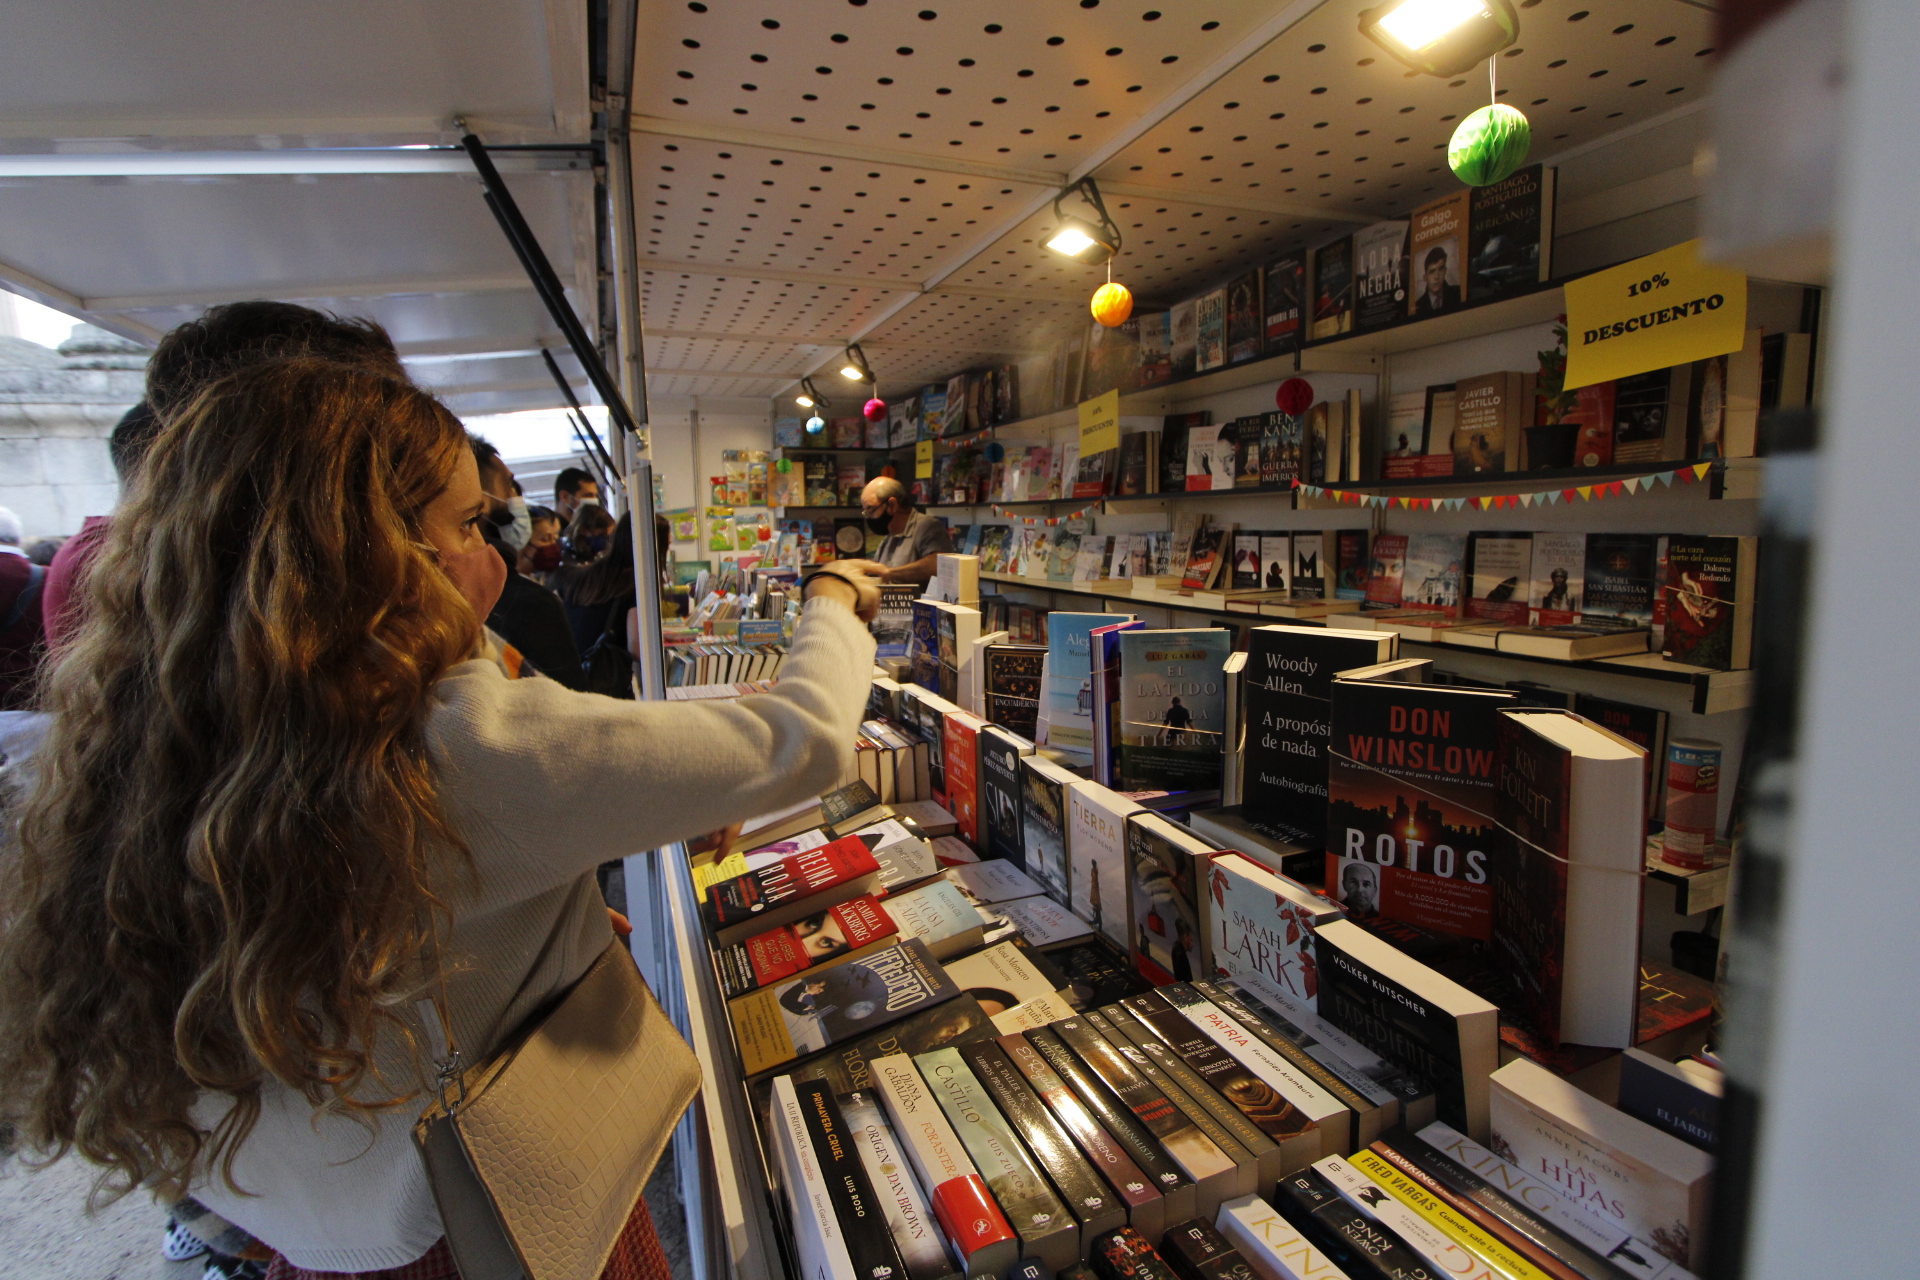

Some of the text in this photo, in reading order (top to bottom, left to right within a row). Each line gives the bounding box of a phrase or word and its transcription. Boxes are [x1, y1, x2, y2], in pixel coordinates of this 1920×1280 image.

[1474, 182, 1537, 210] POSTEGUILLO
[1481, 173, 1529, 198] SANTIAGO
[1415, 219, 1460, 242] corredor
[1421, 210, 1452, 228] Galgo
[1360, 243, 1402, 273] LOBA
[1359, 270, 1402, 299] NEGRA
[1627, 271, 1670, 298] 10%
[1582, 293, 1725, 346] DESCUENTO
[1458, 396, 1502, 411] CASTILLO
[1464, 386, 1495, 400] JAVIER
[1264, 423, 1298, 438] KANE
[1269, 412, 1295, 426] BEN
[1262, 460, 1299, 471] GUERRA
[1670, 553, 1731, 563] norte del corazón
[1676, 545, 1686, 553] La
[1604, 576, 1630, 585] ISABEL
[1699, 572, 1731, 583] Redondo
[1703, 563, 1731, 573] Dolores
[1588, 582, 1603, 591] SAN
[1167, 665, 1187, 678] EL
[1265, 652, 1318, 677] Woody
[1137, 681, 1218, 697] LATIDO
[1189, 708, 1209, 720] LA
[1261, 711, 1273, 727] A
[1390, 705, 1451, 739] DON
[1604, 709, 1631, 726] DON
[1137, 732, 1219, 747] TIERRA
[1261, 732, 1278, 749] de
[1348, 733, 1494, 778] WINSLOW
[1515, 746, 1537, 783] KEN
[1259, 771, 1328, 797] Autobiografía
[1500, 763, 1552, 829] FOLLETT
[1073, 799, 1117, 843] TIERRA
[1090, 834, 1114, 853] MORENO
[1129, 841, 1137, 851] de
[1134, 835, 1154, 854] El mal
[1345, 827, 1487, 885] ROTOS
[757, 863, 797, 904] ROJA
[796, 849, 839, 889] REINA
[836, 902, 871, 942] LÄCKBERG
[854, 900, 882, 931] CAMILLA
[1232, 910, 1281, 951] SARAH
[751, 939, 772, 976] PERDONAN
[765, 939, 783, 964] QUE NO
[777, 933, 796, 962] MUJERES
[1221, 918, 1300, 998] LARK
[905, 963, 916, 973] EL
[996, 945, 1030, 981] Rosa Montero
[851, 945, 927, 1012] HEREDERO
[1332, 954, 1427, 1018] VOLKER KUTSCHER
[1247, 979, 1298, 1013] Javier Marías
[1372, 1000, 1389, 1023] EL
[1204, 1013, 1249, 1048] PATRIA
[1315, 1023, 1347, 1047] Berta Isla
[1335, 994, 1437, 1078] EXPEDIENTE
[976, 1055, 994, 1078] LIBROS
[1016, 1046, 1030, 1062] El
[993, 1060, 1001, 1068] EL
[1001, 1066, 1020, 1090] TALLER
[1251, 1048, 1315, 1100] Fernando Aramburu
[1273, 1038, 1303, 1059] ARTURO
[1302, 1058, 1361, 1103] PÉREZ-REVERTE
[884, 1067, 918, 1115] GABALDON
[898, 1073, 922, 1103] DIANA
[935, 1065, 980, 1123] CASTILLO
[964, 1085, 974, 1094] EL
[1155, 1078, 1239, 1153] ARTURO PÉREZ-REVERTE
[1176, 1070, 1259, 1143] ARTURO PÉREZ-REVERTE
[1657, 1107, 1671, 1122] EL
[811, 1092, 845, 1162] PRIMAVERA CRUEL
[920, 1121, 961, 1178] FORASTERA
[987, 1138, 1024, 1189] LUIS ZUECO
[1535, 1126, 1572, 1152] ANNE
[1576, 1150, 1630, 1184] JACOBS
[865, 1124, 927, 1241] ORIGEN DAN BROWN
[1383, 1148, 1437, 1187] HAWKING
[1443, 1138, 1560, 1214] KING
[1564, 1157, 1597, 1185] LAS
[843, 1175, 865, 1219] LUIS ROSO
[1424, 1151, 1548, 1235] La playa de los ahogados
[1540, 1156, 1625, 1219] HIJAS
[1361, 1156, 1529, 1276] FRED VARGAS Cuando sale reclusa
[1341, 1224, 1381, 1257] OWEN
[1350, 1218, 1394, 1252] KING
